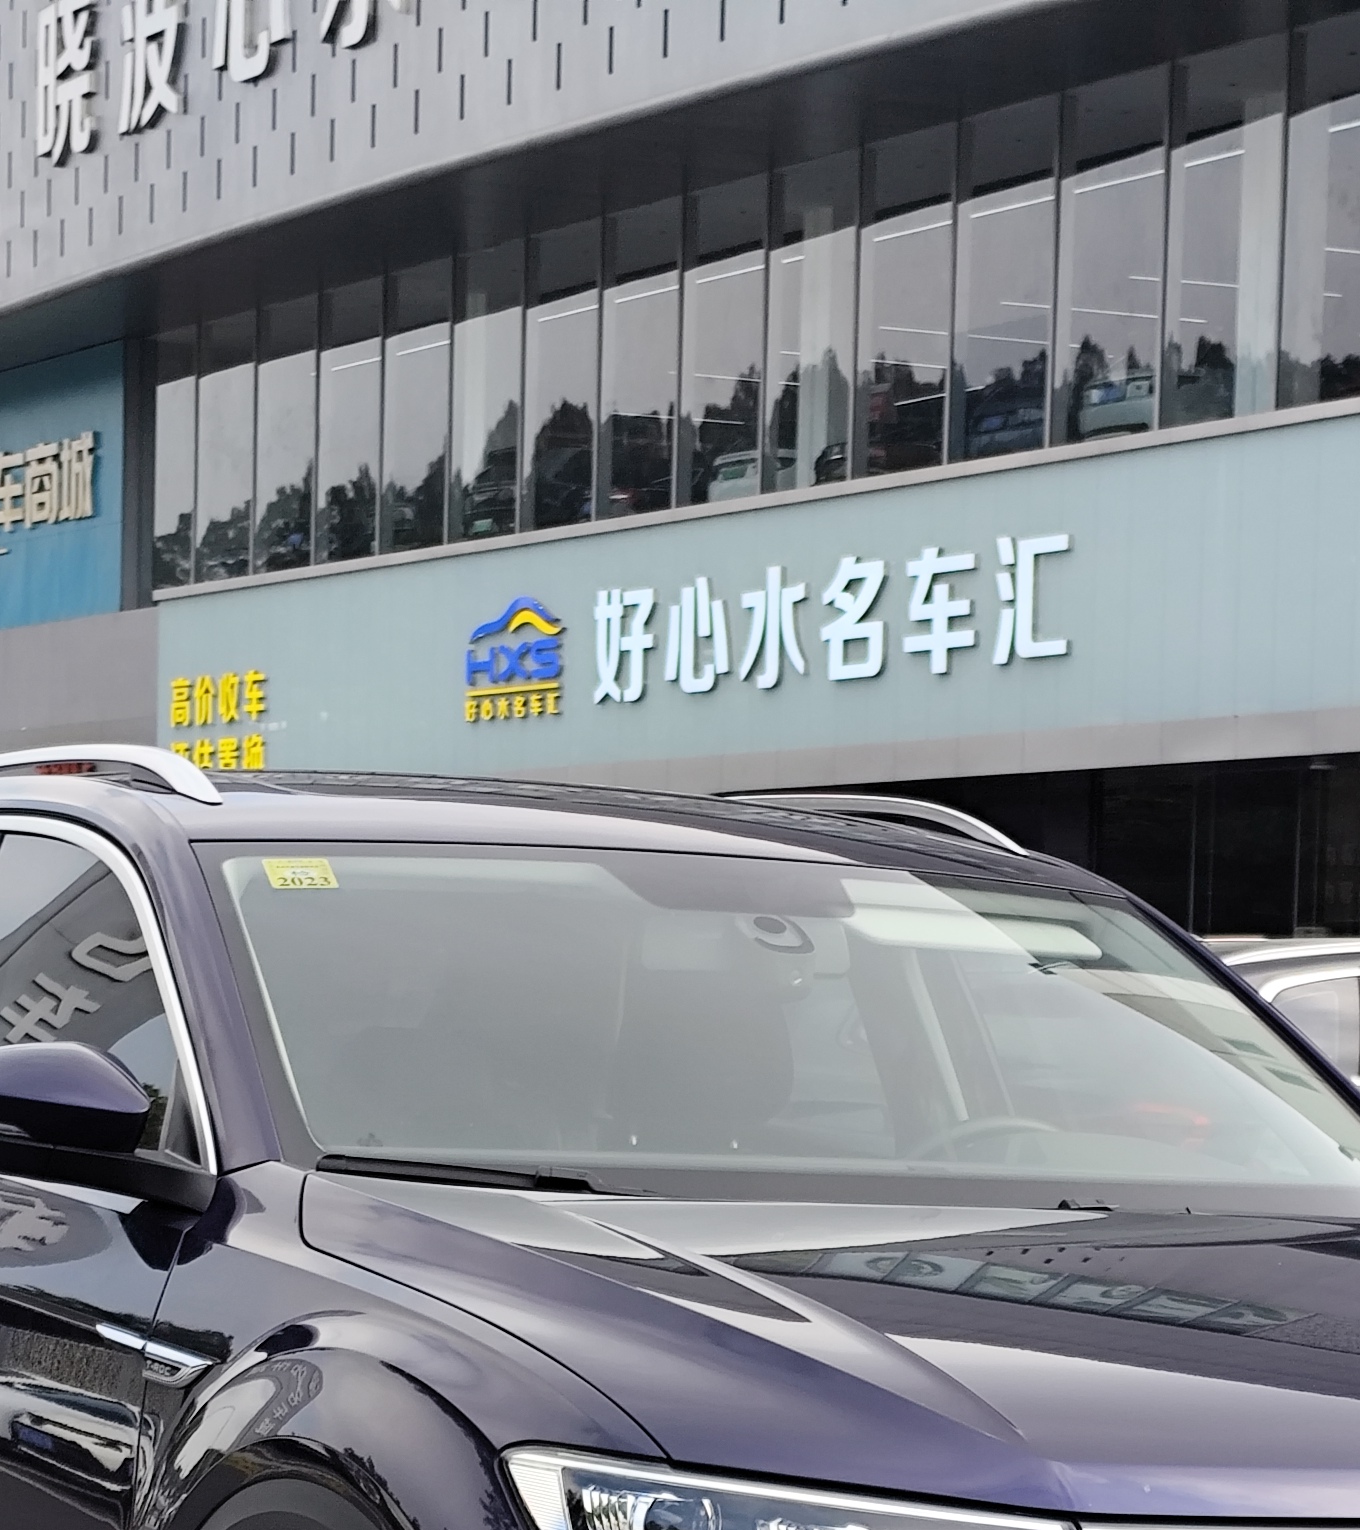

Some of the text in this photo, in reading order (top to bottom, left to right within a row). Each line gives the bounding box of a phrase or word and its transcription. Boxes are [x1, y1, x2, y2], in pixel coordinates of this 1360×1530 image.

[593, 533, 1071, 705] 好心水名车汇
[466, 638, 560, 685] HXS
[170, 669, 266, 728] 高价收车
[465, 692, 561, 722] 好心水名车汇
[277, 876, 331, 887] 2023
